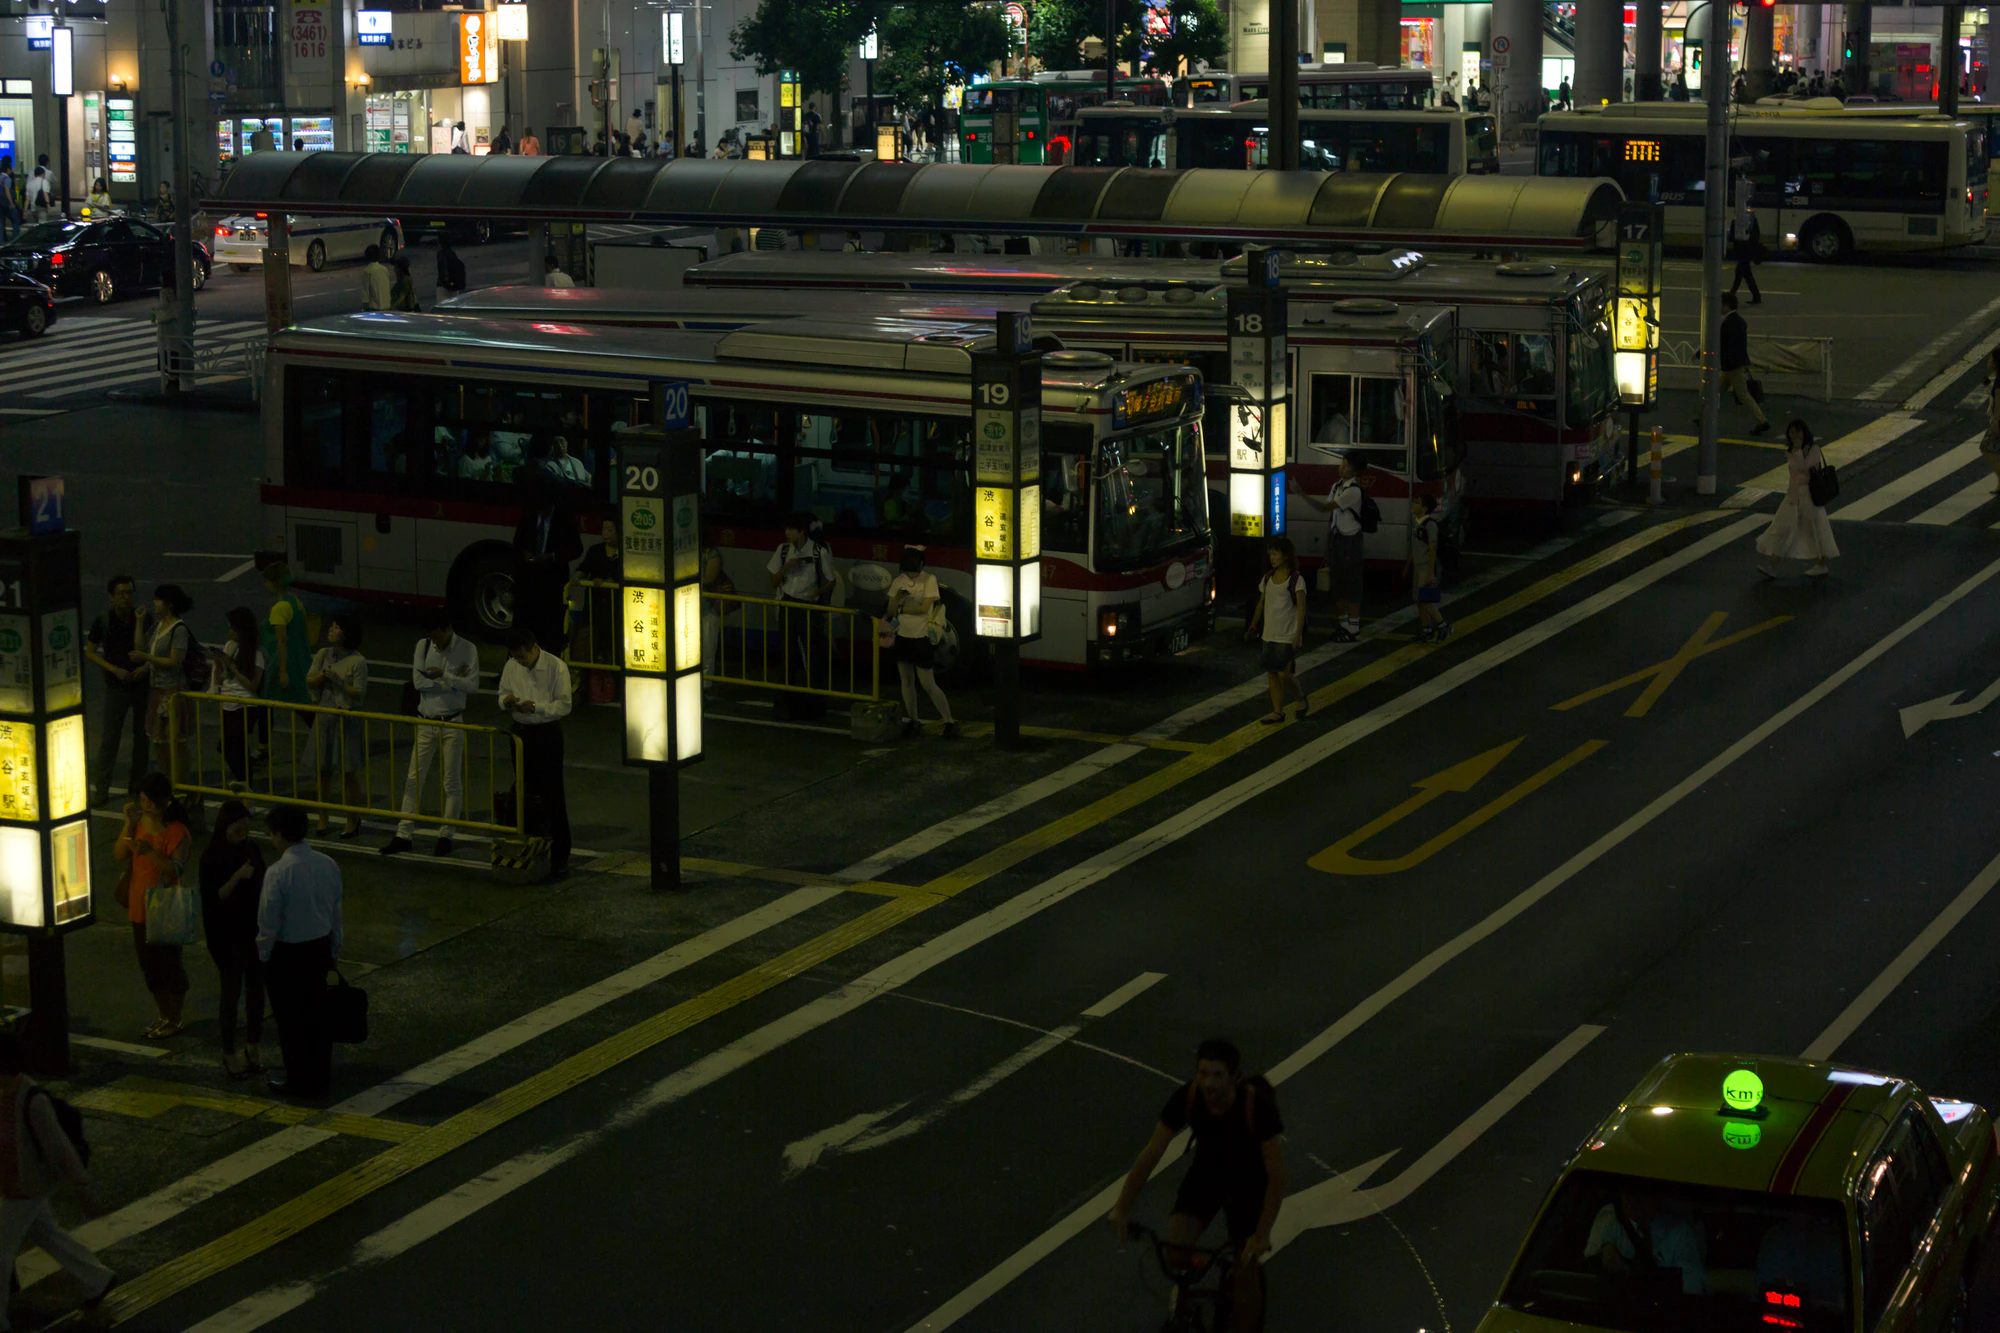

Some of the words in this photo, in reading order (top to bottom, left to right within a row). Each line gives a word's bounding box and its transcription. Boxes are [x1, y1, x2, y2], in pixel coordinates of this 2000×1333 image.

[291, 25, 327, 41] (3461)
[294, 42, 325, 57] 1616
[1623, 223, 1648, 240] 17
[1267, 254, 1279, 279] 18
[1015, 315, 1032, 344] 19
[1234, 313, 1263, 333] 18
[666, 386, 688, 421] 20
[978, 382, 1009, 405] 19
[625, 465, 659, 492] 20
[36, 484, 64, 522] 21
[983, 489, 995, 553] 渋谷駅
[998, 512, 1007, 554] 道玄坂上
[631, 590, 646, 663] 渋谷駅
[650, 616, 660, 664] 道玄坂上
[0, 724, 16, 809] 渋谷駅
[20, 757, 32, 811] 道玄坂上
[1726, 1086, 1752, 1100] km
